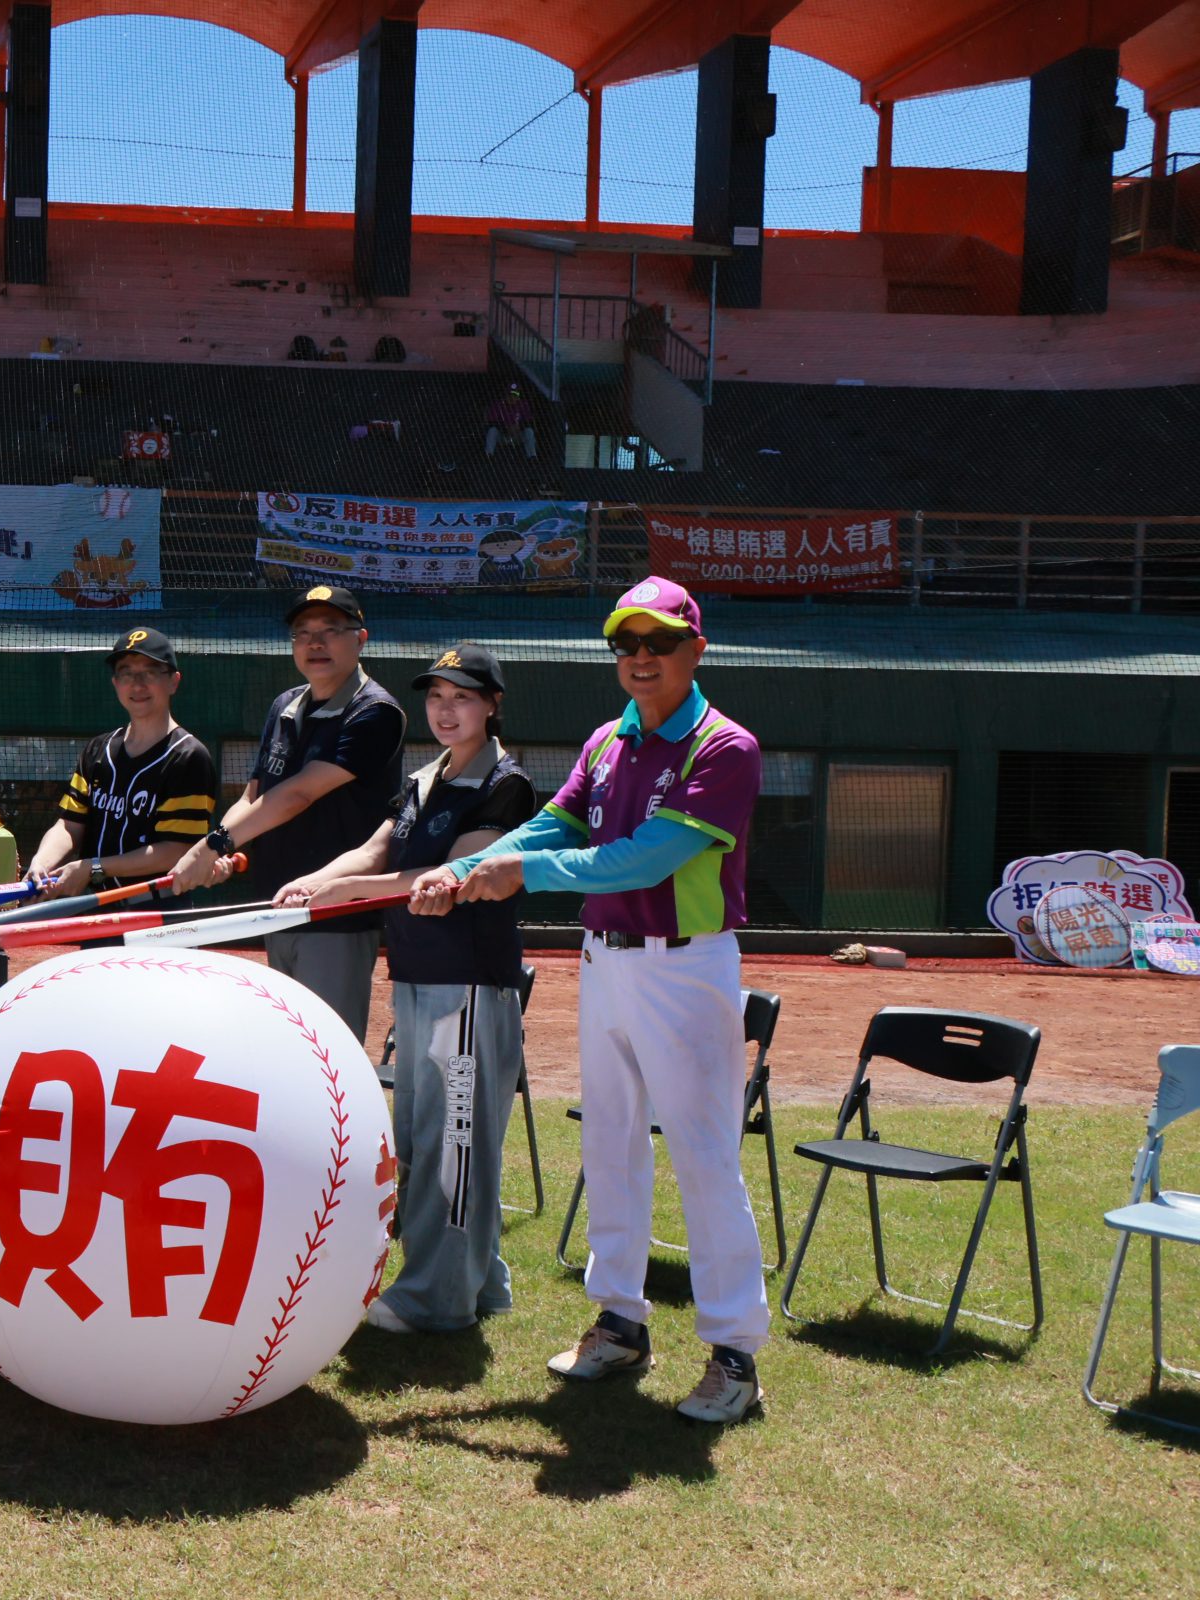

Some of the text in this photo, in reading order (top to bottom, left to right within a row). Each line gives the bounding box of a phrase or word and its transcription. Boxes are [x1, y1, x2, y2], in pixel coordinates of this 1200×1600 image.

[304, 496, 417, 528] 反賄選
[429, 512, 516, 527] 人人有責
[687, 518, 892, 559] 檢舉賄選 人人有責
[304, 551, 339, 568] 500
[126, 630, 148, 649] P
[1050, 902, 1105, 933] 陽光
[1063, 926, 1120, 957] 屏東
[445, 1055, 475, 1145] SMILE
